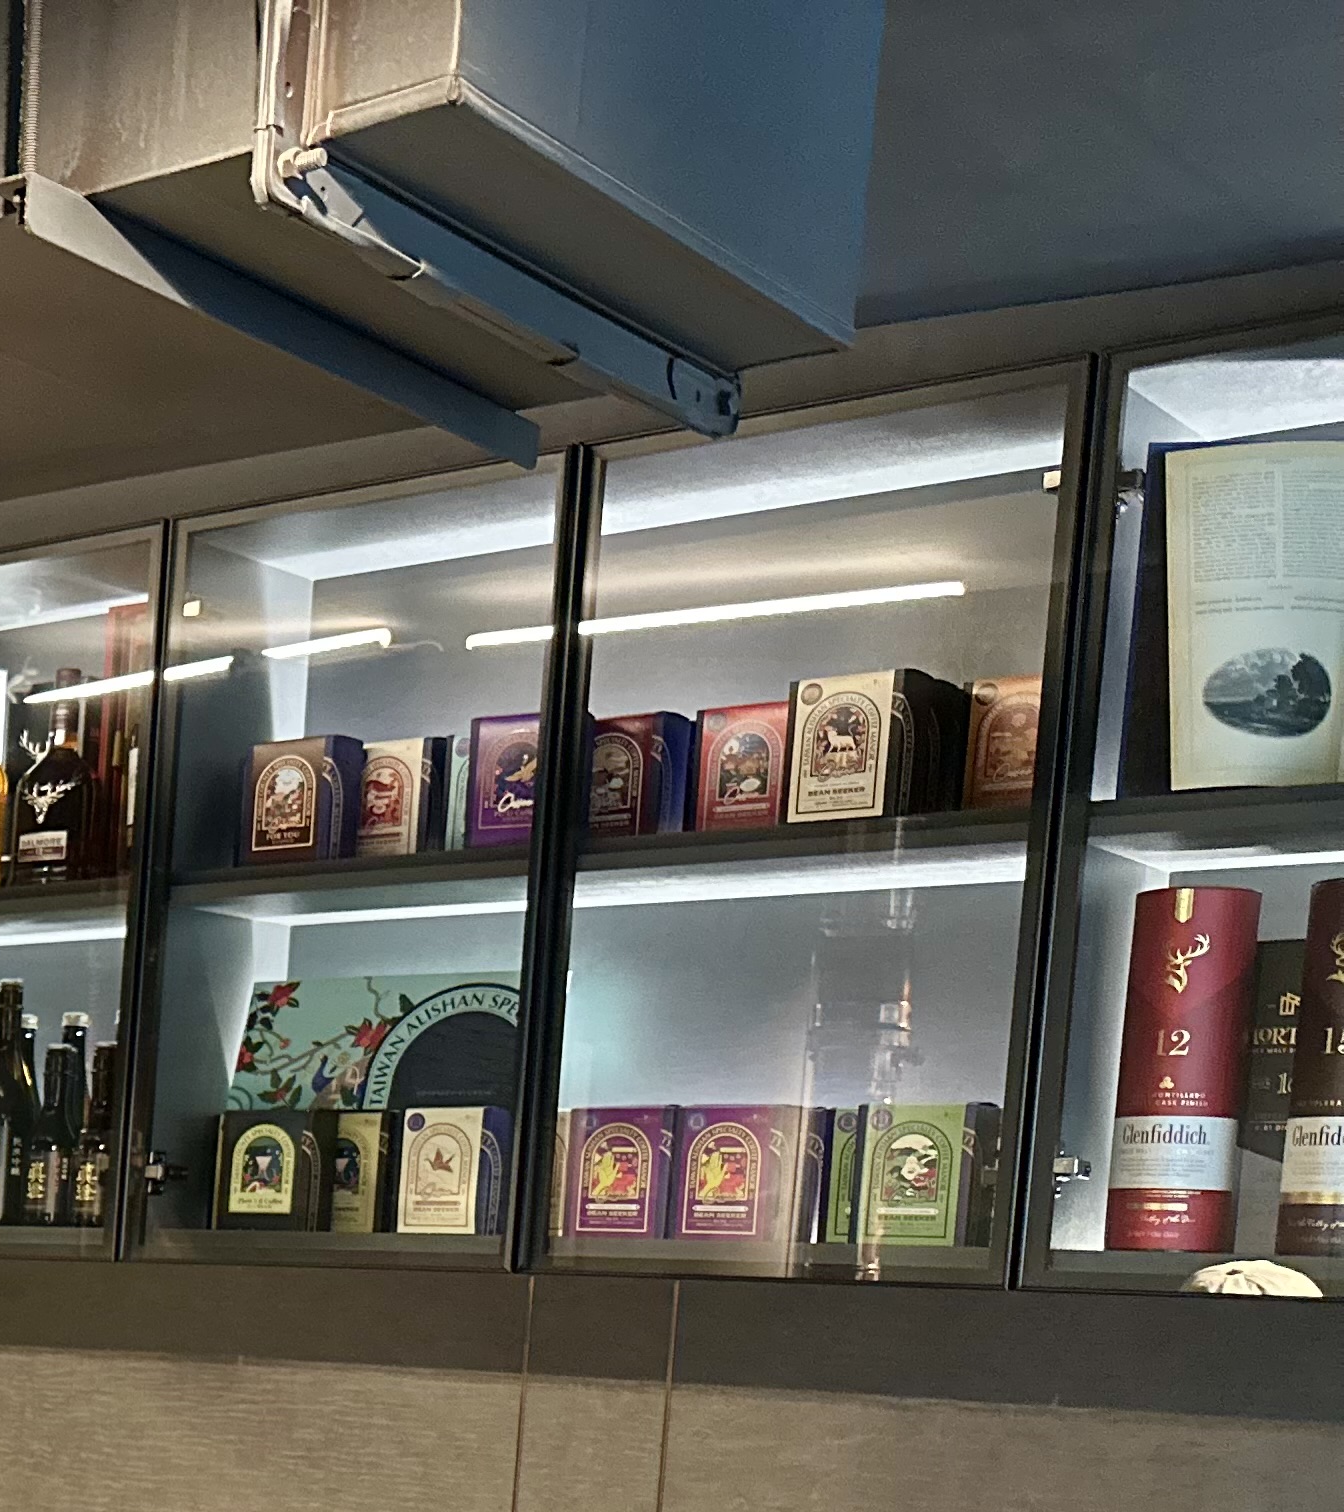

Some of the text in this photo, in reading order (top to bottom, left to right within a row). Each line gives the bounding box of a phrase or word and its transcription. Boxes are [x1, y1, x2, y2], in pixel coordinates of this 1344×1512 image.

[370, 1034, 405, 1107] TAIWAN
[405, 992, 486, 1036] ALISHAN
[1156, 1029, 1191, 1057] 12
[1122, 1123, 1207, 1146] Glenfiddich
[1292, 1124, 1344, 1148] Glenfid
